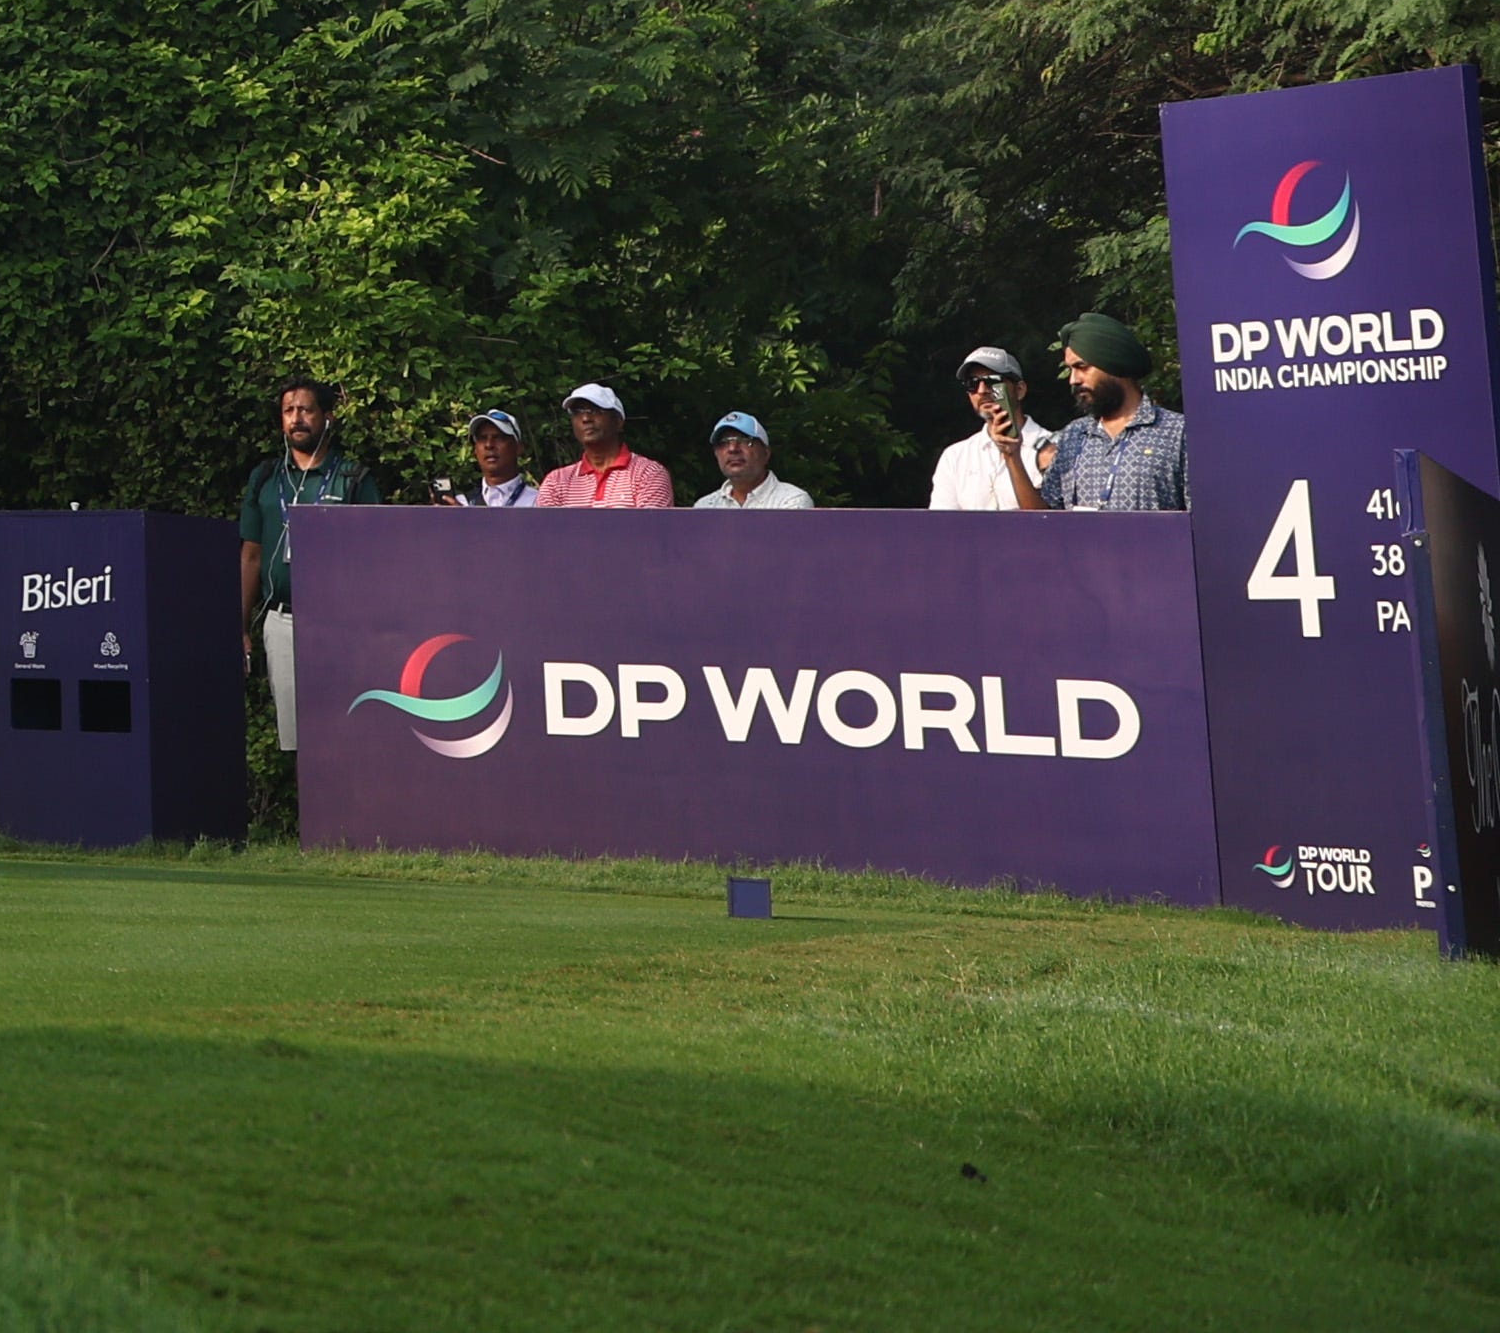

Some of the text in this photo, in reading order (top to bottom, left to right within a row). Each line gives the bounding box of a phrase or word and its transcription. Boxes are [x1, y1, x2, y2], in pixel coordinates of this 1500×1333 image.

[1211, 308, 1445, 363] DP WORLD
[1215, 355, 1447, 392] INDIA CHAMPIONSHIP
[1366, 488, 1401, 520] 41
[1247, 479, 1336, 638] 4
[22, 565, 111, 612] Bisleri
[1376, 601, 1411, 632] PA
[543, 661, 1141, 760] DP WORLD
[1298, 845, 1371, 863] DP WORLD
[1300, 861, 1375, 895] TOUR
